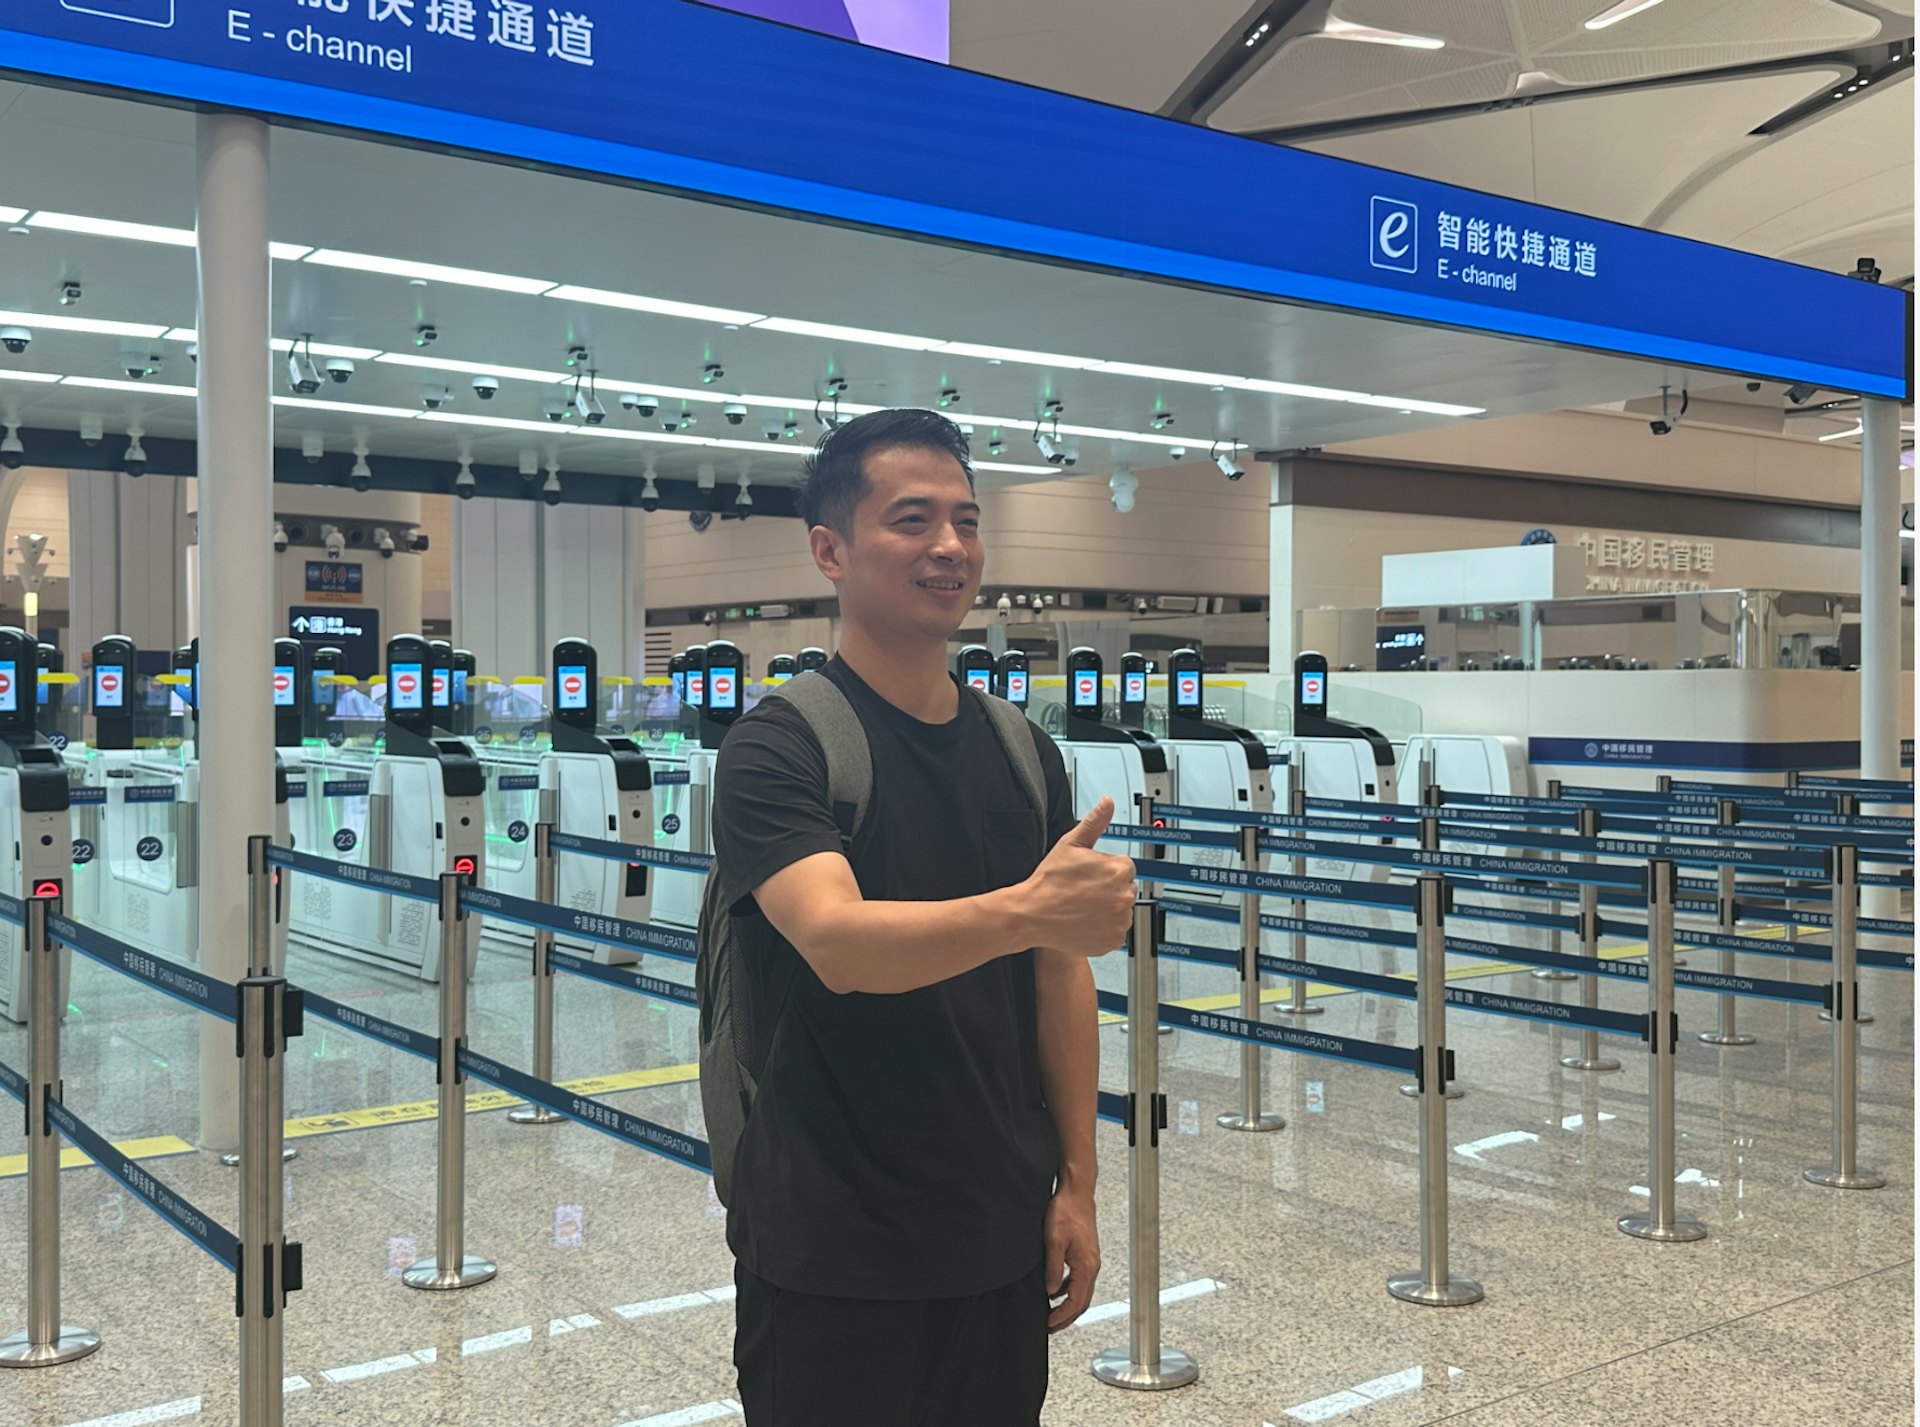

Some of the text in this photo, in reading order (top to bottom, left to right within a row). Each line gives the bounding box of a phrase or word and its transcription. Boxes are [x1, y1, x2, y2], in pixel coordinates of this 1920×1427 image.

[227, 9, 252, 42] E
[286, 24, 412, 73] channel
[1437, 210, 1597, 278] 智能快捷通道
[1438, 258, 1449, 279] E
[1462, 264, 1517, 291] channel
[664, 818, 679, 831] 25
[1793, 813, 1847, 825] 中国移民管理
[337, 833, 354, 847] 23
[510, 826, 526, 839] 24
[1655, 823, 1795, 841] 中国移民管理 CHINA IMMIGRATION
[72, 844, 91, 858] 22
[140, 842, 160, 856] 22
[1596, 841, 1752, 861] 中国移民管理 CHINA IMMIGRATION
[1412, 852, 1568, 875] 中国移民管理 CHINA IMMIGRATION
[1190, 868, 1342, 894] 中国移民管理 CHINA IMMIGRATION
[573, 915, 695, 951] 中国移民管理 CHINA IMMIGRATION
[1716, 937, 1741, 947] CHINA
[1741, 940, 1794, 953] IMMIGRATION
[1598, 960, 1753, 990] 中国移民管 HINA IMMIGRATION
[1481, 996, 1509, 1009] CHINA
[1509, 1000, 1570, 1018] IMMIGRATION
[1190, 1013, 1343, 1052] 中国移民管理 CHINA IMMIGRATION
[573, 1099, 695, 1156] 中国移民管理 CHINA IMMIGRATION
